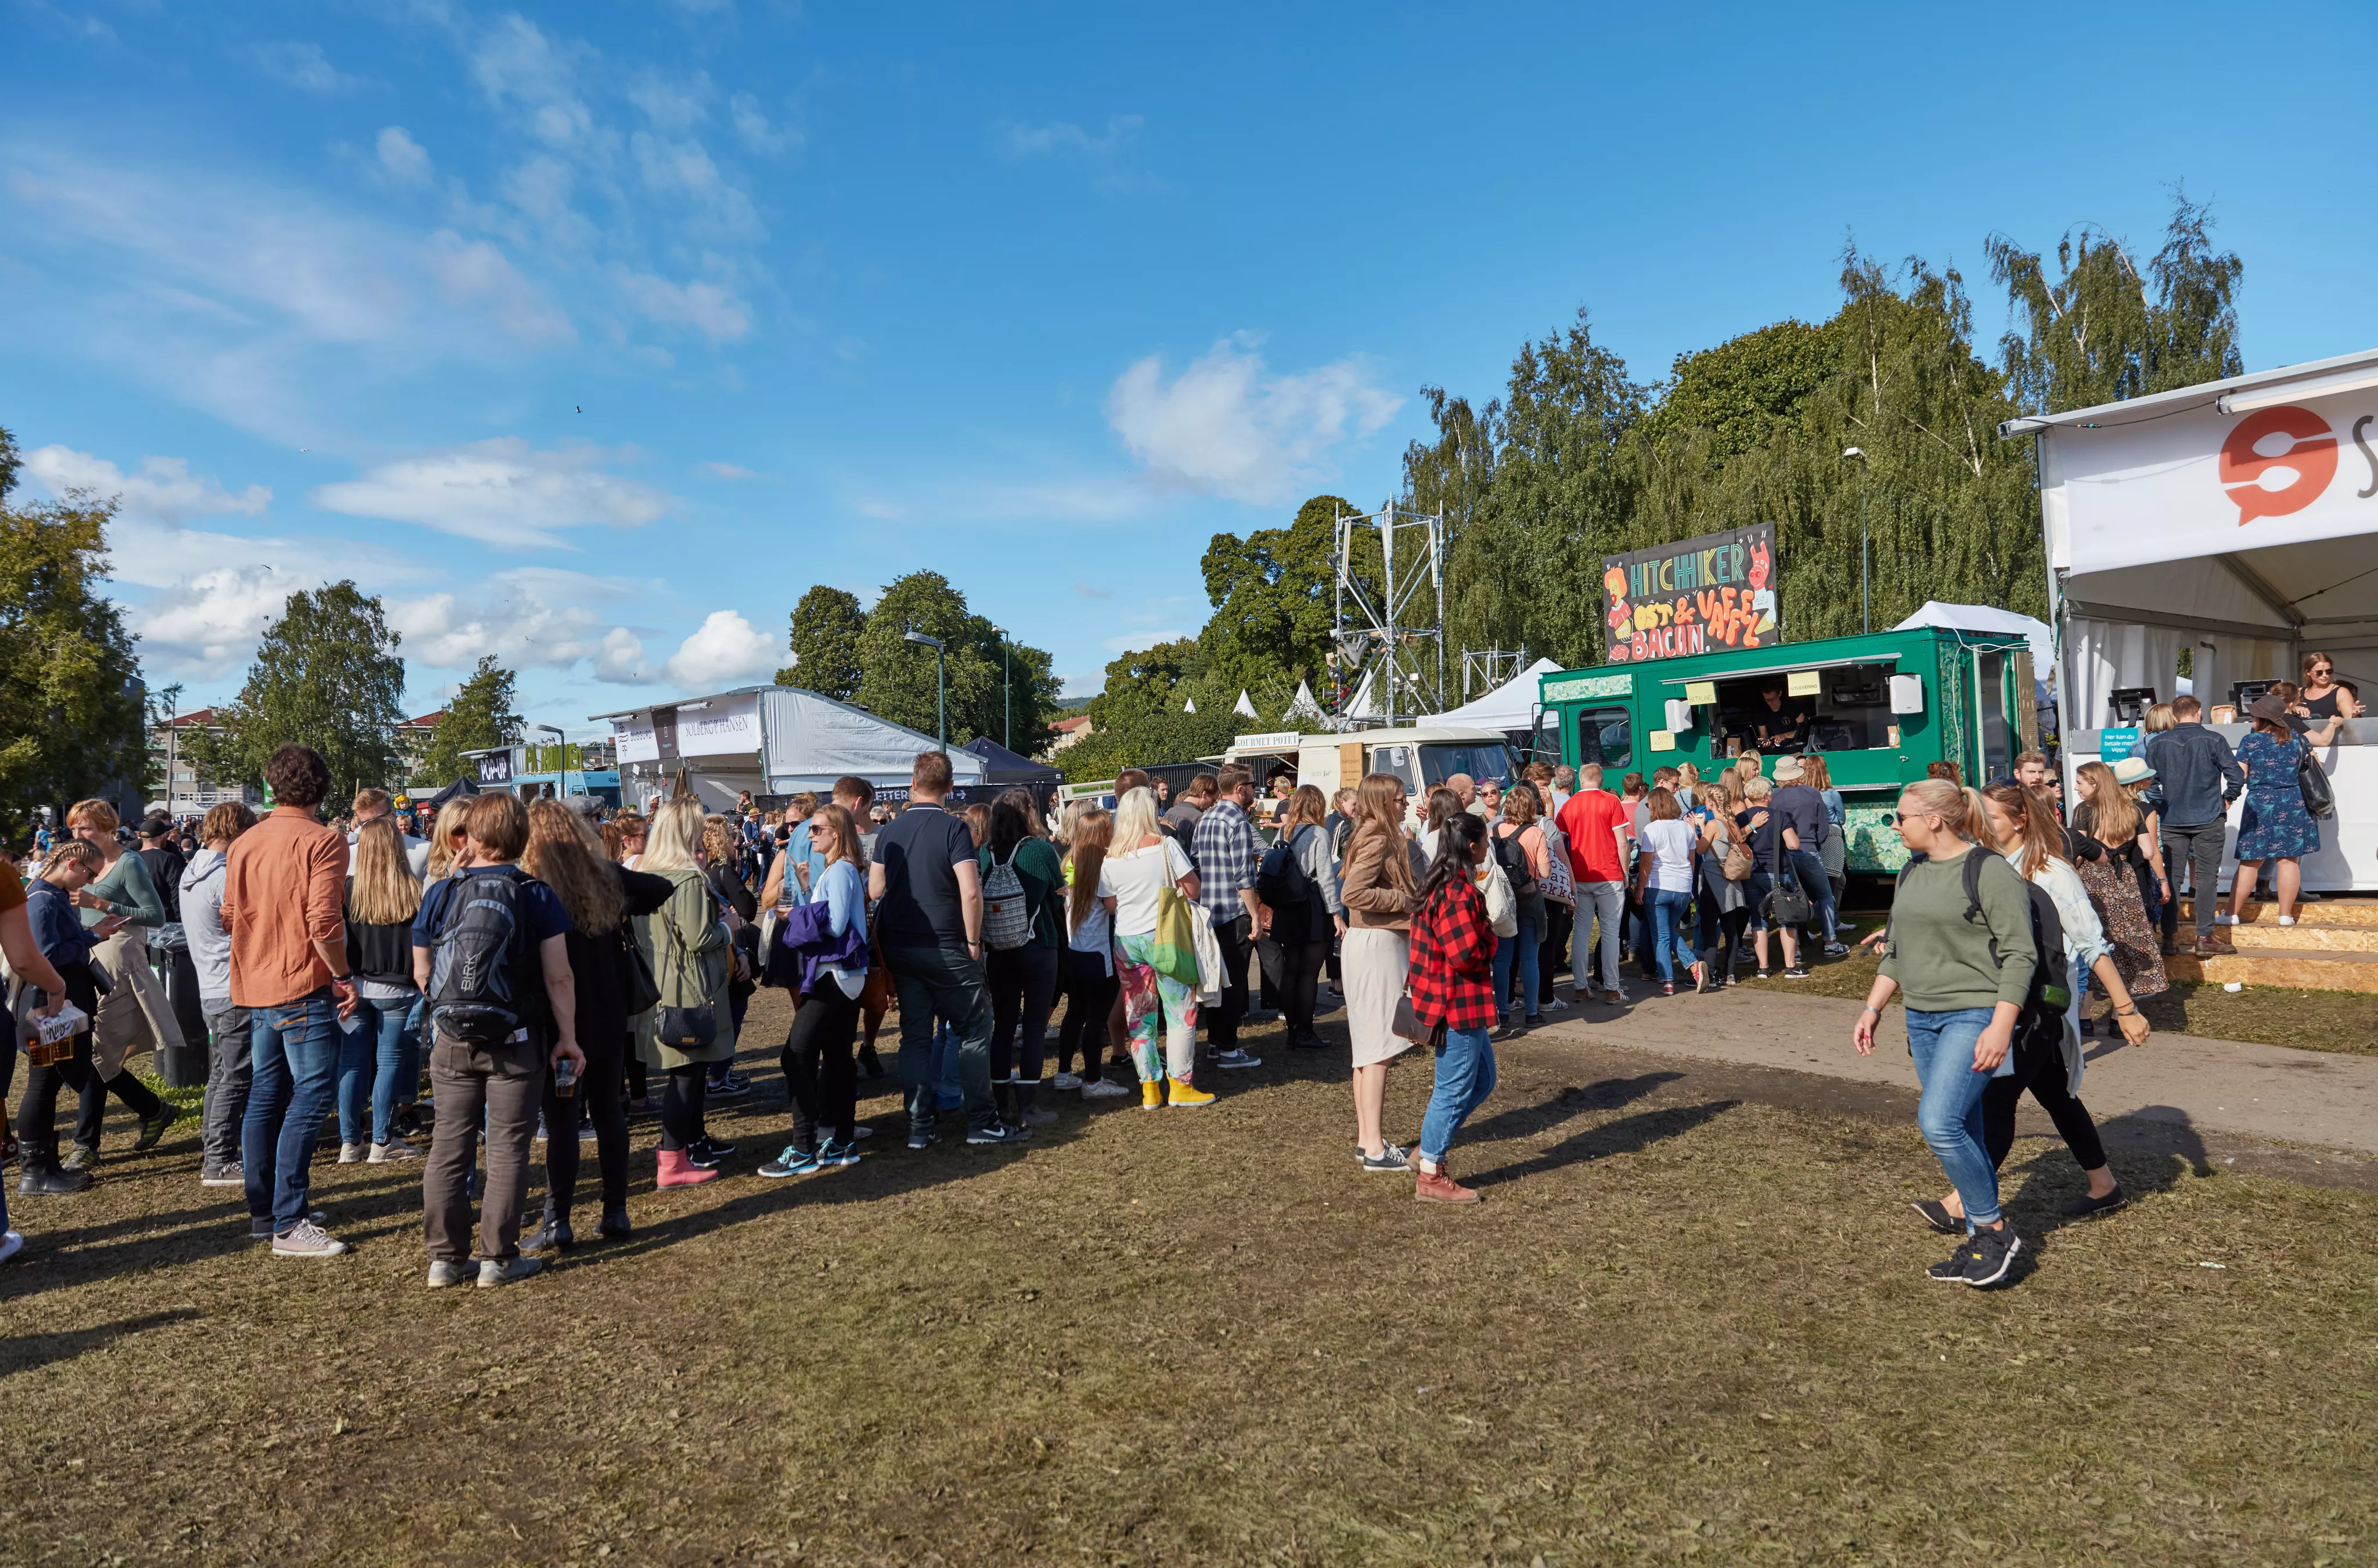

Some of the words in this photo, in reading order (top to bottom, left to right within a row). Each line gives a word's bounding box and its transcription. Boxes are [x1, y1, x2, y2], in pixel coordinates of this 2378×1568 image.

[1630, 543, 1745, 598] HITCHHIKER
[1633, 601, 1674, 631] OST
[1674, 597, 1696, 625] &
[1696, 586, 1761, 648] VAFFEL
[1689, 694, 1713, 702] BETALING
[630, 730, 652, 741] DUGGURD
[685, 720, 714, 737] SOLBERG
[720, 715, 748, 733] HANSEN
[1236, 737, 1271, 748] GOURMET
[1273, 735, 1298, 745] POTET
[480, 756, 507, 781] POP-UP
[874, 790, 908, 801] ETTER
[460, 950, 482, 992] BIRK
